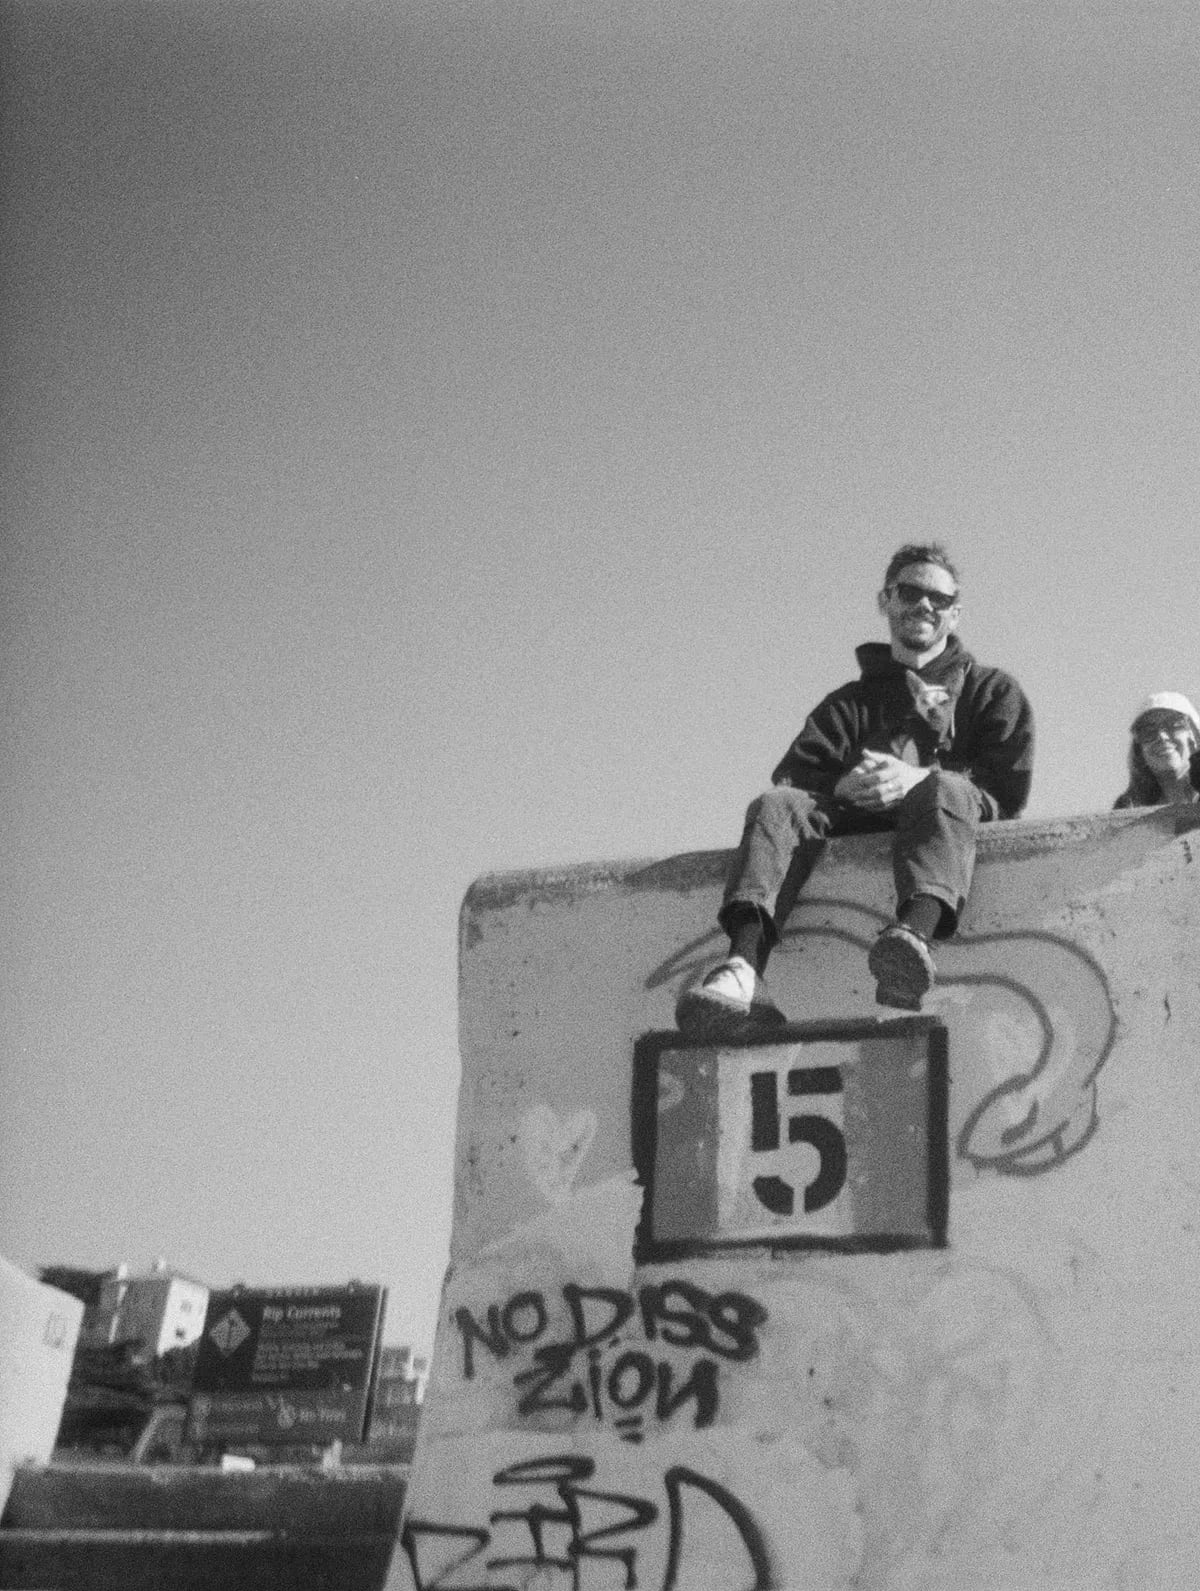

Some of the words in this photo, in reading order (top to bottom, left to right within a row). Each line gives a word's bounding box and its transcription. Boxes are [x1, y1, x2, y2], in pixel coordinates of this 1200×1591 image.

[750, 1065, 848, 1216] 5
[455, 1290, 548, 1381] NO
[563, 1279, 769, 1362] DISS
